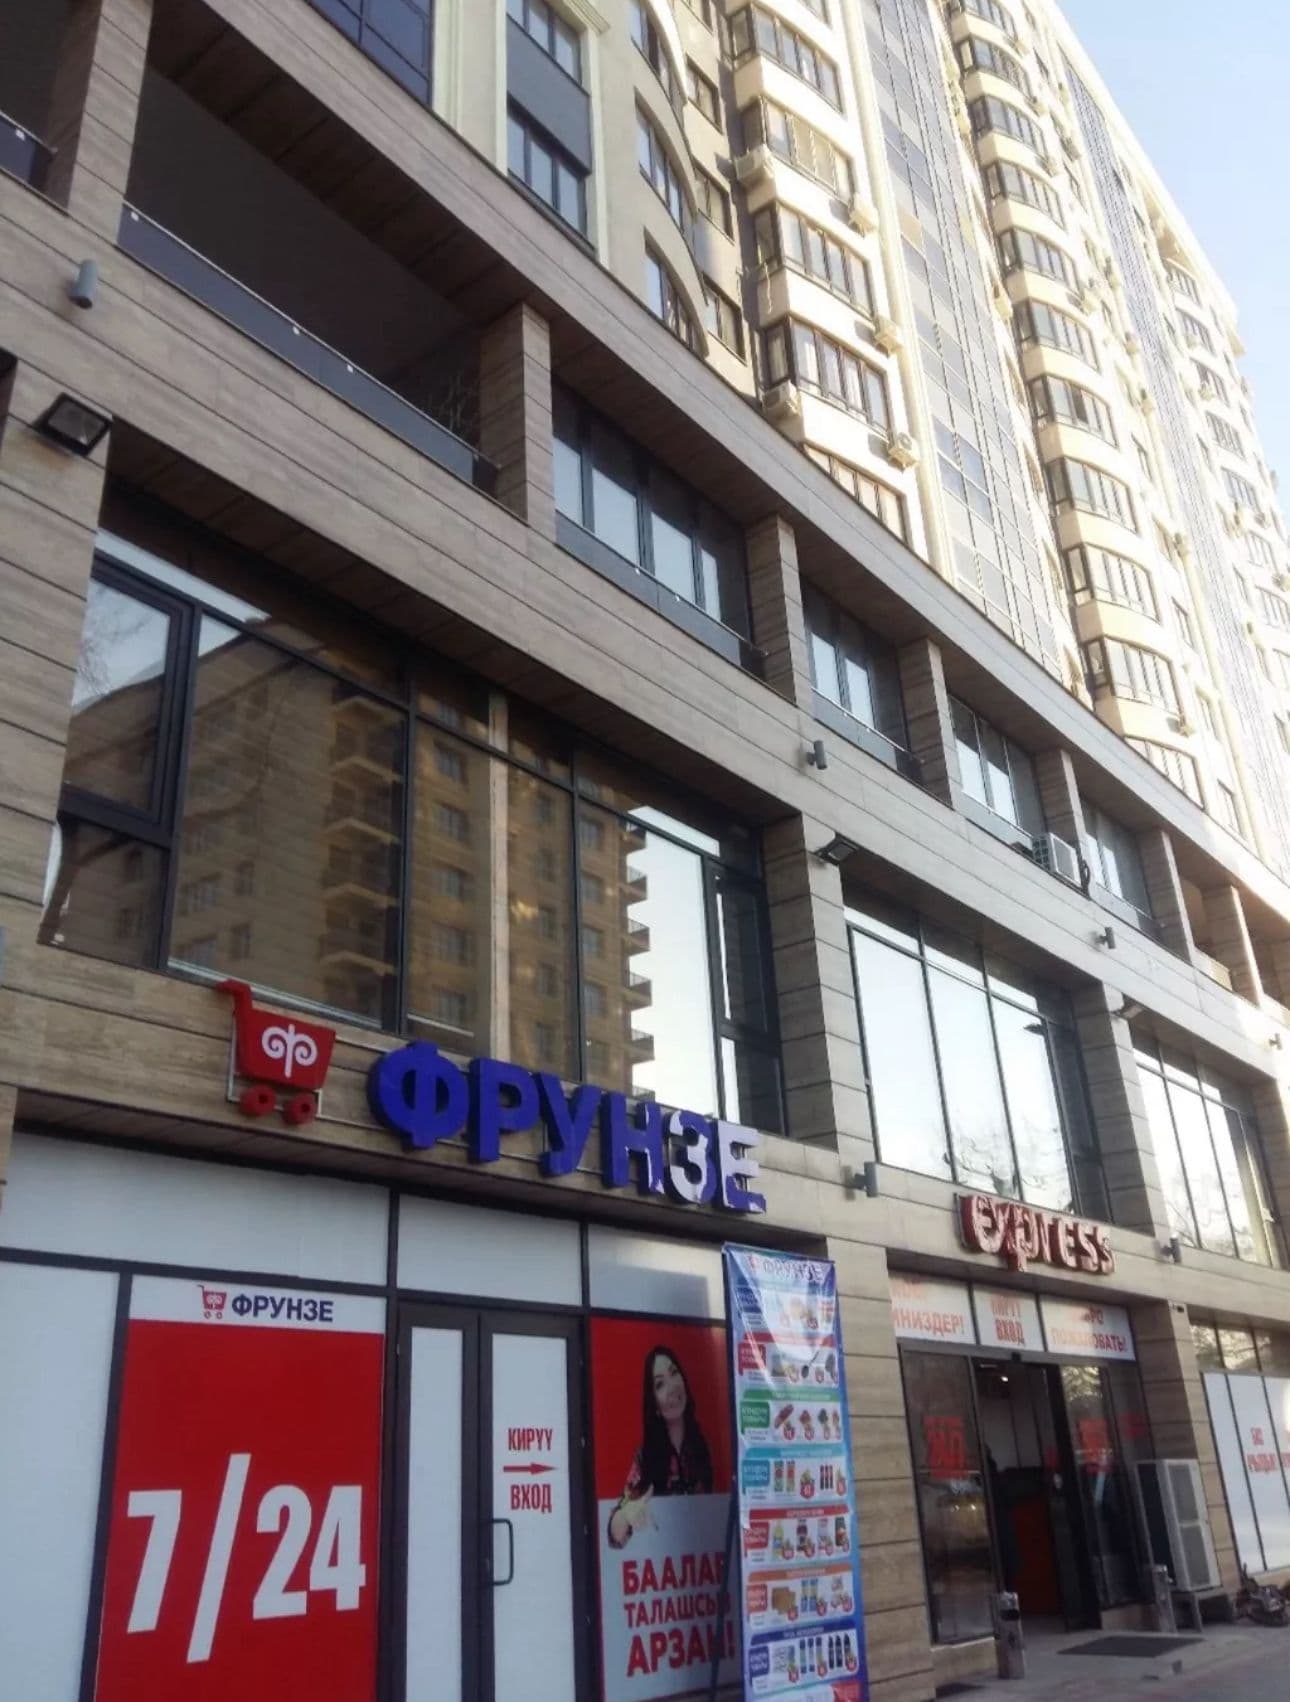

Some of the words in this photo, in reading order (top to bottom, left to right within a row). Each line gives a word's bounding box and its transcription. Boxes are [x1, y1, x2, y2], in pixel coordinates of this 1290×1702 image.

[367, 1040, 766, 1214] ФРУНЗЕ
[231, 1293, 334, 1323] ФРУНЗЕ
[510, 1483, 552, 1515] ВХОД
[126, 1453, 366, 1664] 7/24
